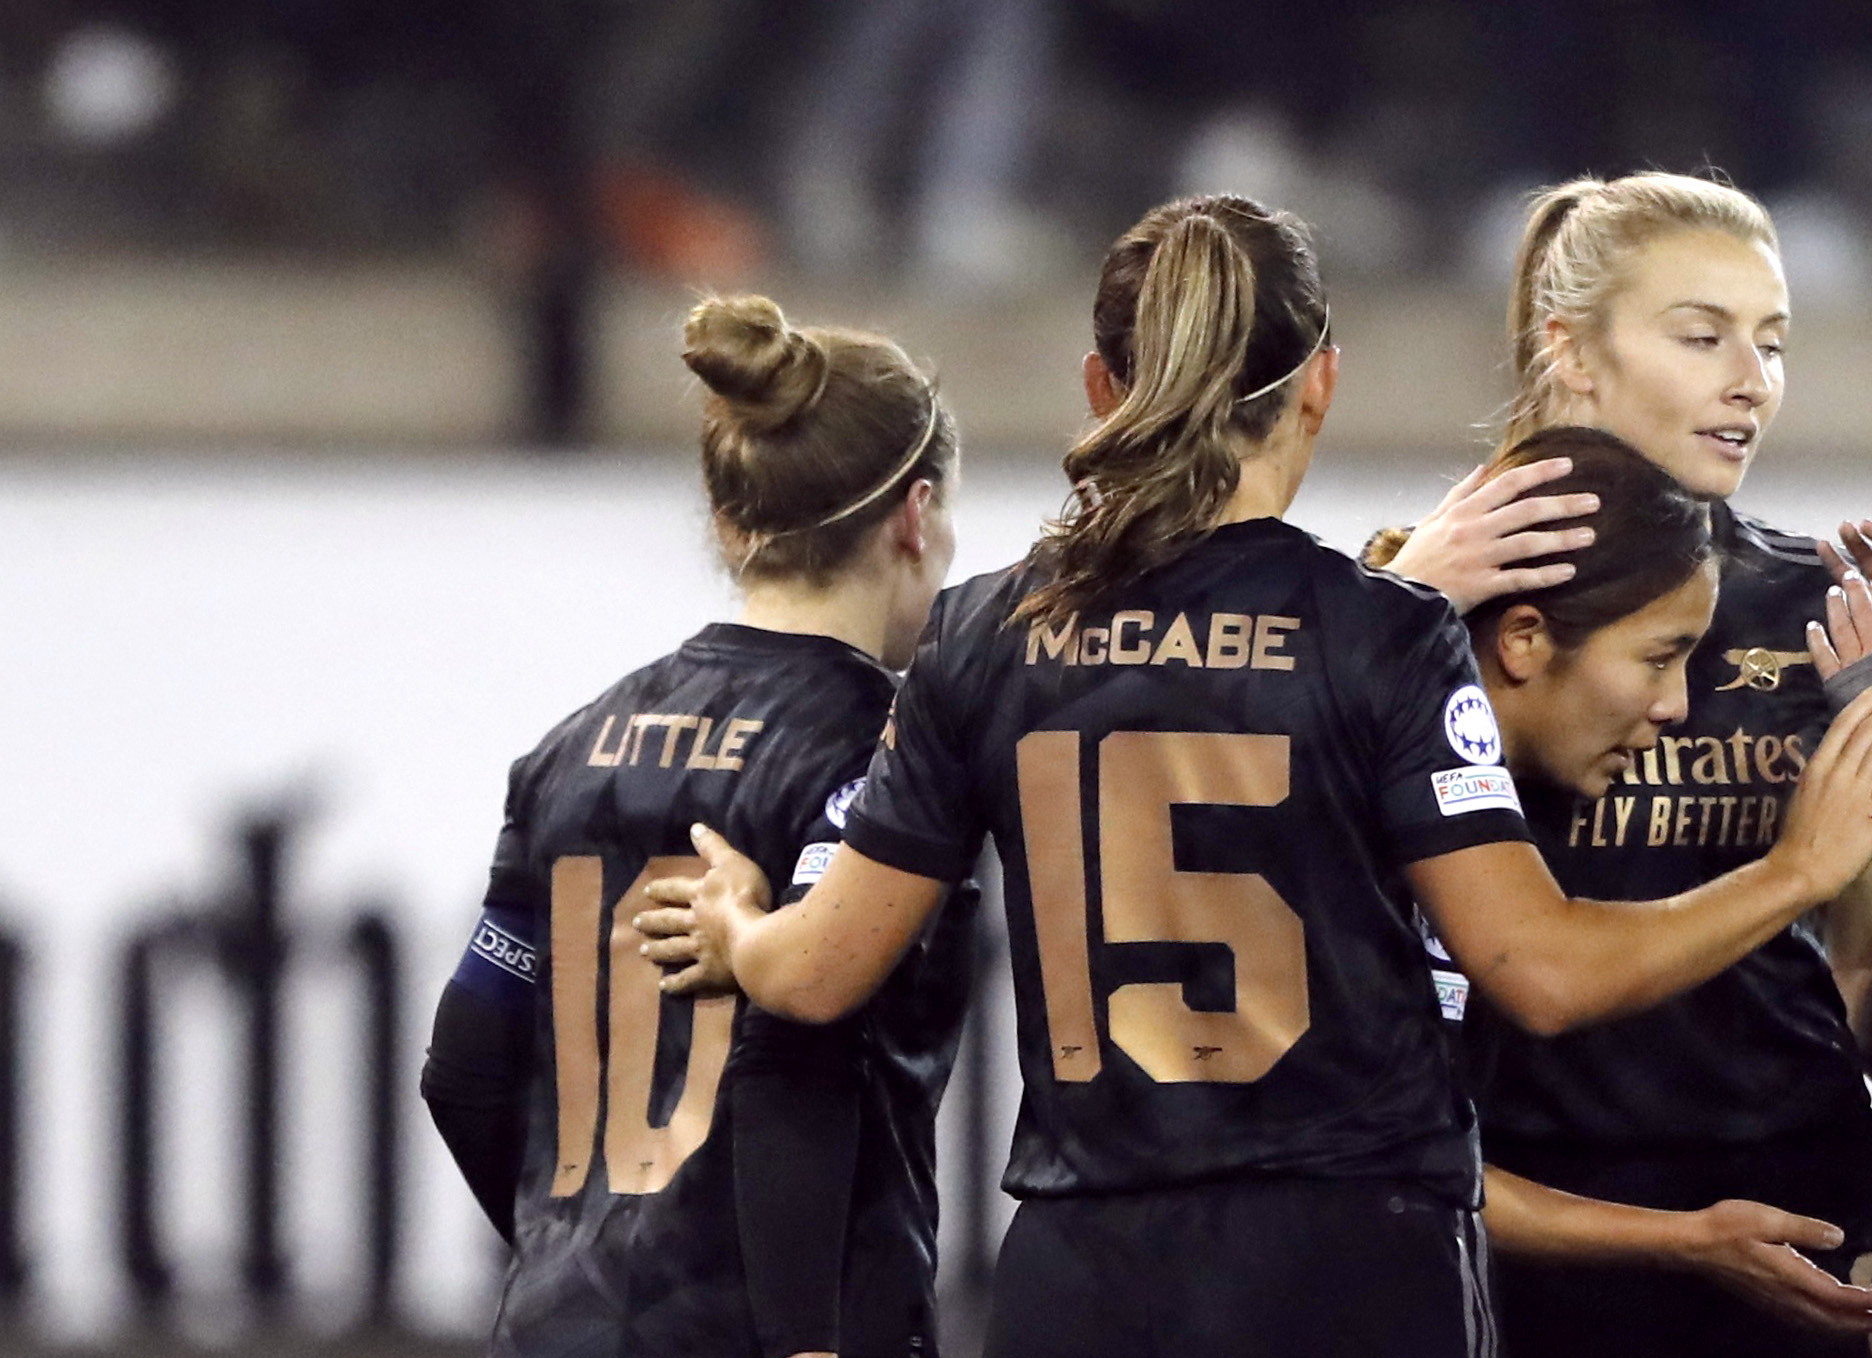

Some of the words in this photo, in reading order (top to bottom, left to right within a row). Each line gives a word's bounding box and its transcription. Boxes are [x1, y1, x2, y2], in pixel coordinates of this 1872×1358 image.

[1024, 610, 1301, 671] McCABE
[587, 713, 765, 771] LITTLE
[1610, 727, 1807, 786] irates
[1436, 772, 1464, 784] UEFA
[1646, 795, 1779, 848] BETTER
[1015, 730, 1311, 1084] 15
[549, 855, 738, 1198] 10
